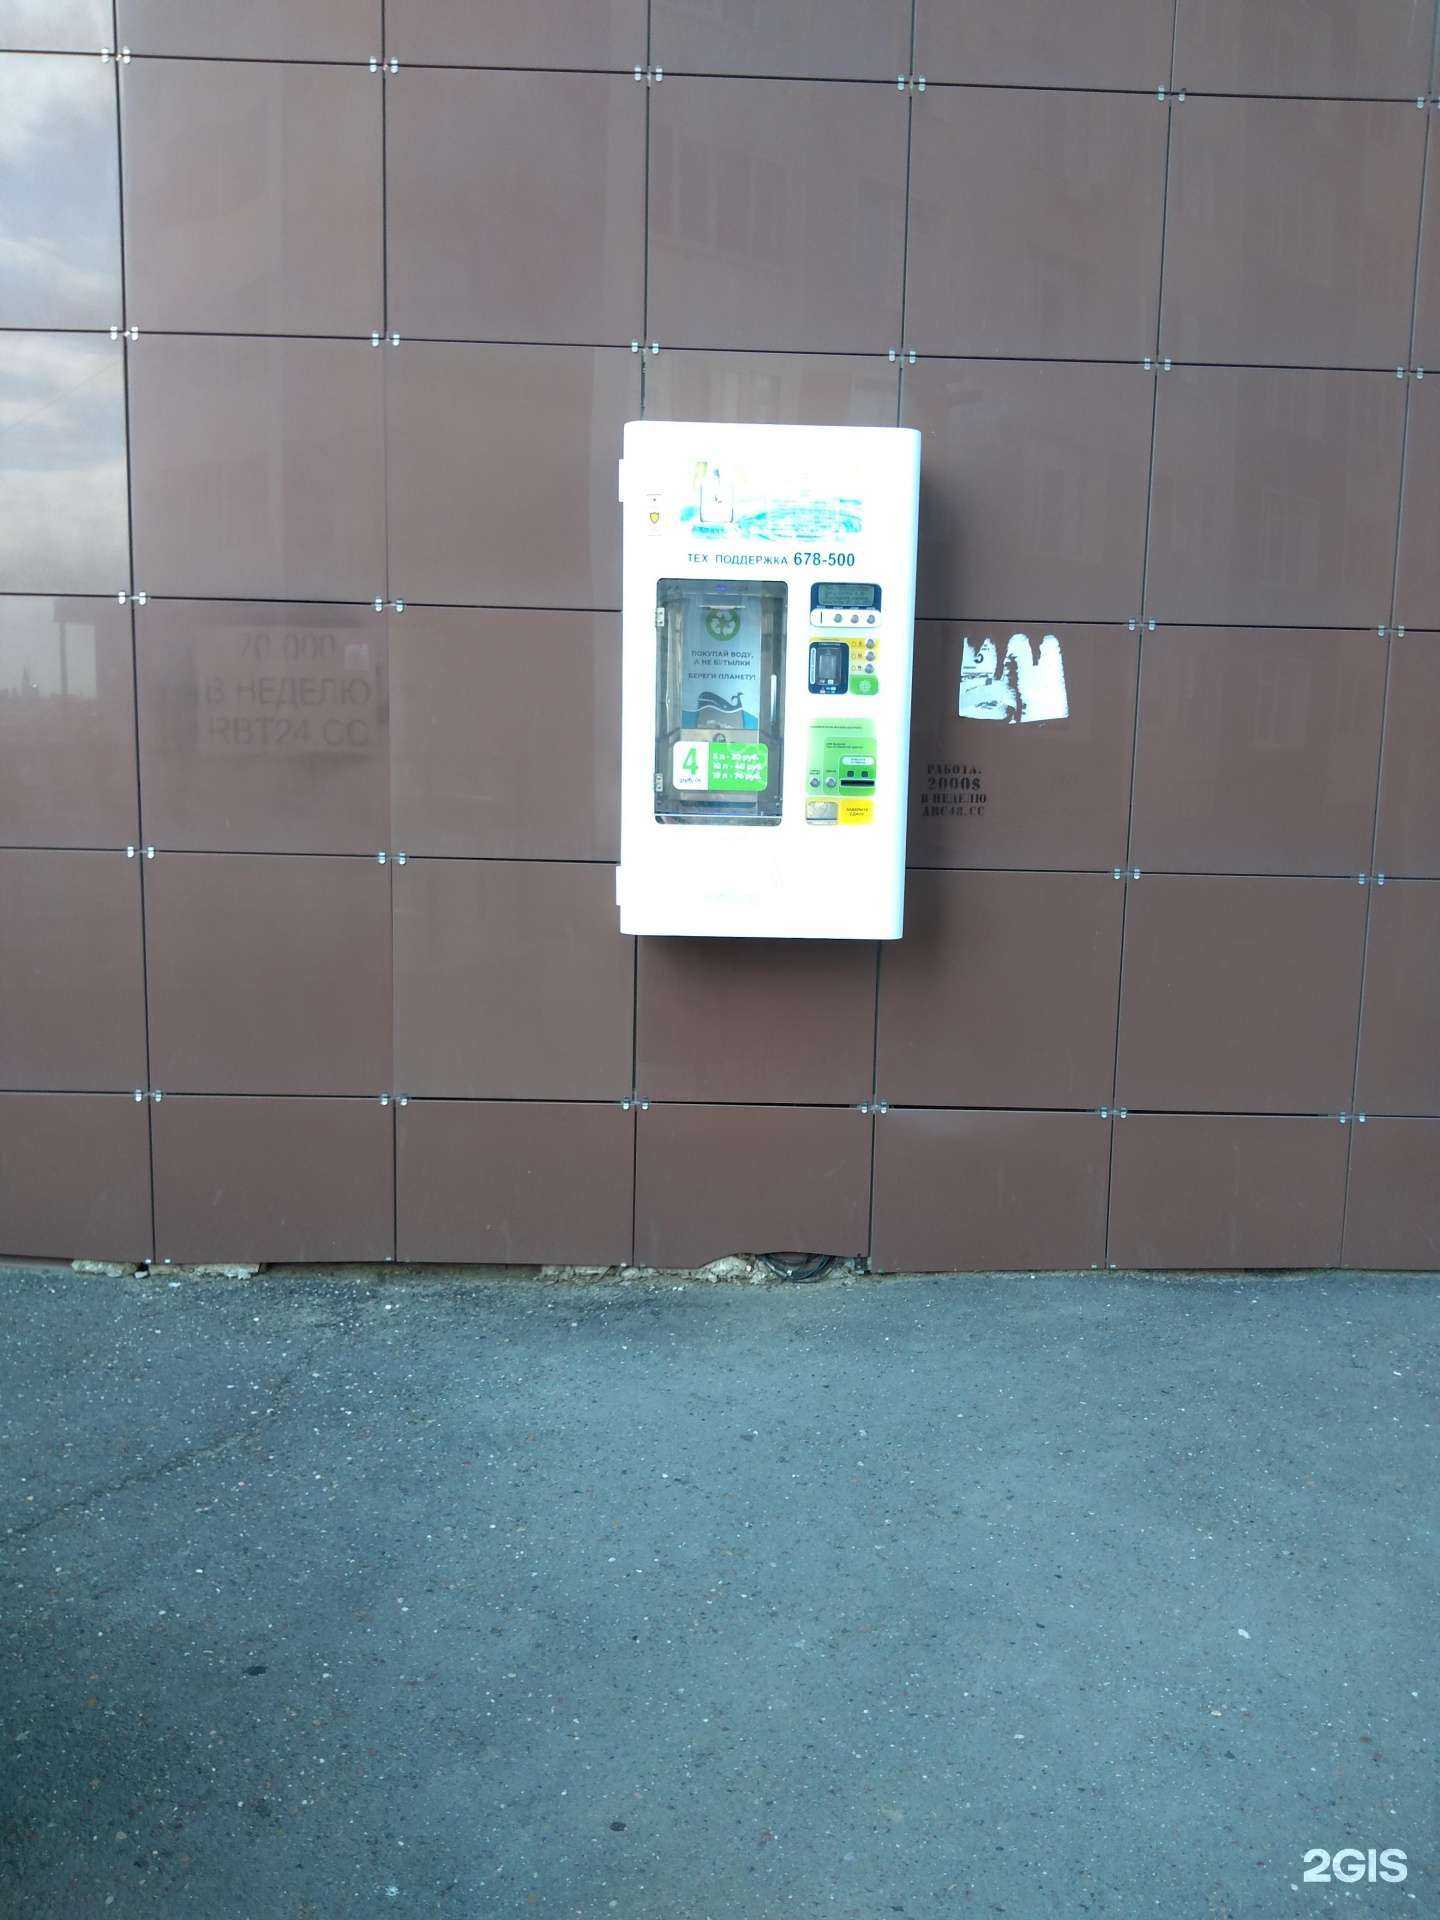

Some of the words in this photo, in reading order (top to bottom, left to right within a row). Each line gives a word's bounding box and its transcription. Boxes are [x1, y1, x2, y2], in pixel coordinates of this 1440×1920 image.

[687, 553, 709, 563] ТЕХ
[715, 554, 789, 566] ПОДДЕРЖКА
[793, 552, 855, 567] 678-500
[691, 649, 729, 657] ПОКУПАЙ
[730, 651, 754, 659] ВОДУ,
[713, 659, 751, 667] БУТЫЛКИ
[688, 672, 717, 680] БЕРЕГИ
[718, 673, 756, 681] ПЛАНЕТУ!
[237, 676, 372, 710] НЕДЕЛЮ
[682, 748, 699, 775] 4
[927, 776, 981, 791] 2000$
